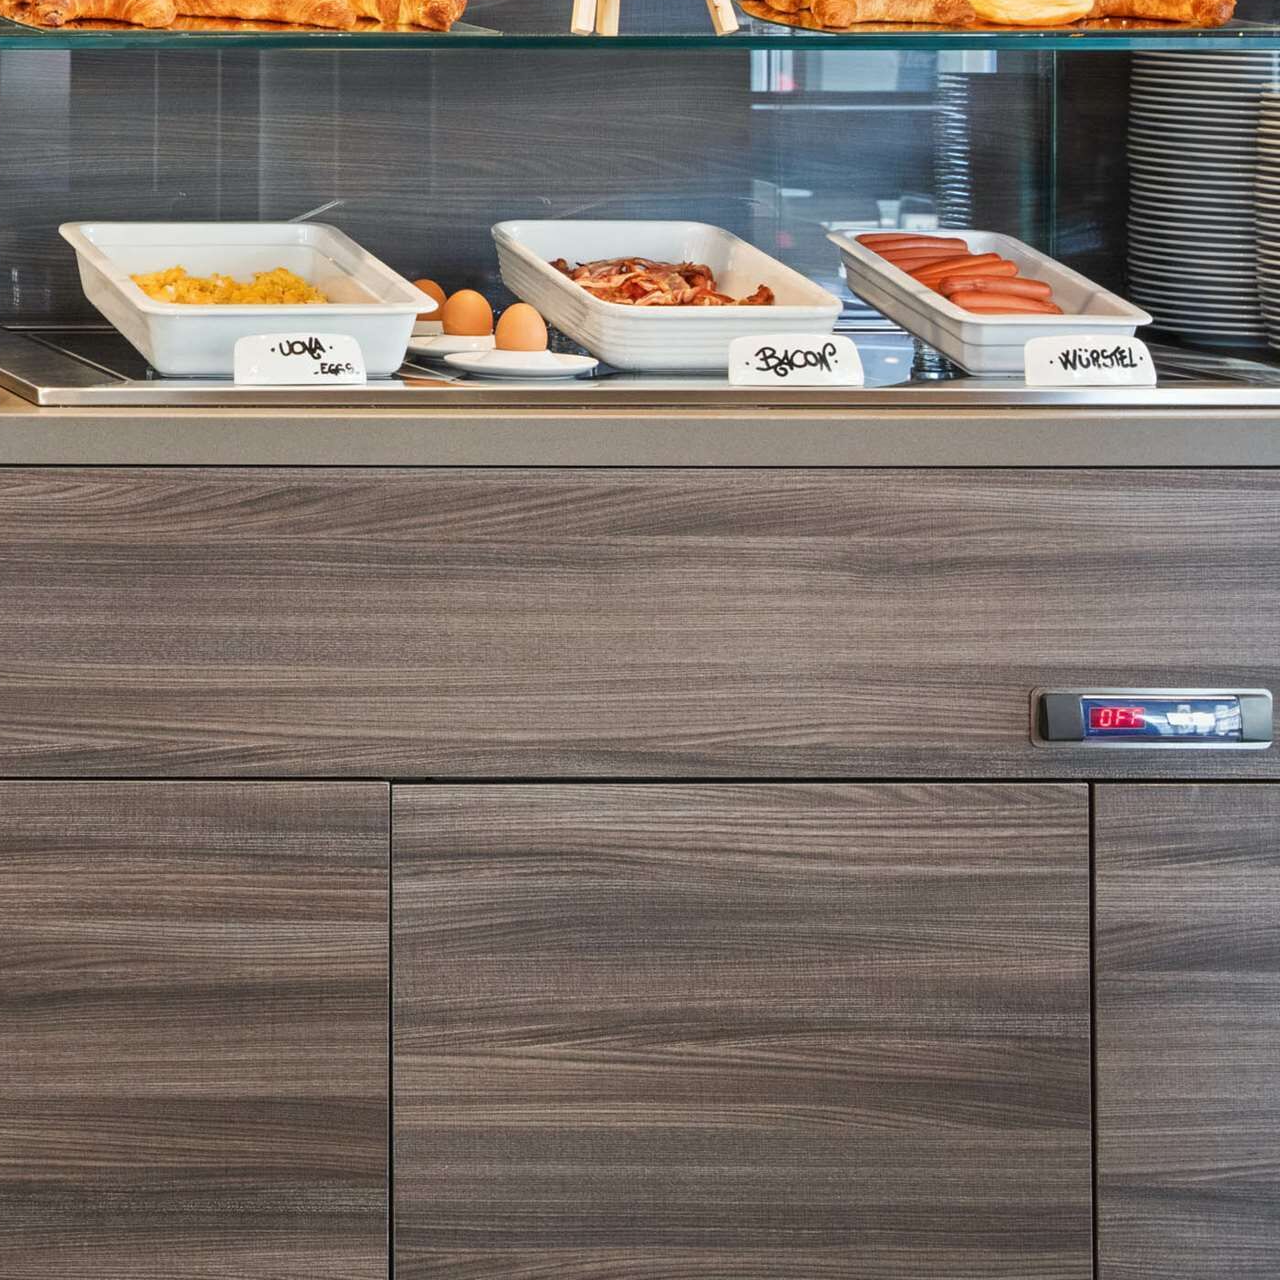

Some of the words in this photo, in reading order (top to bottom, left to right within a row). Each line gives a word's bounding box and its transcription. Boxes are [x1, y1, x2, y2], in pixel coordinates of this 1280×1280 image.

[754, 342, 837, 377] BACON
[1058, 345, 1138, 370] WÜRSTEL
[1100, 708, 1143, 727] OFF
